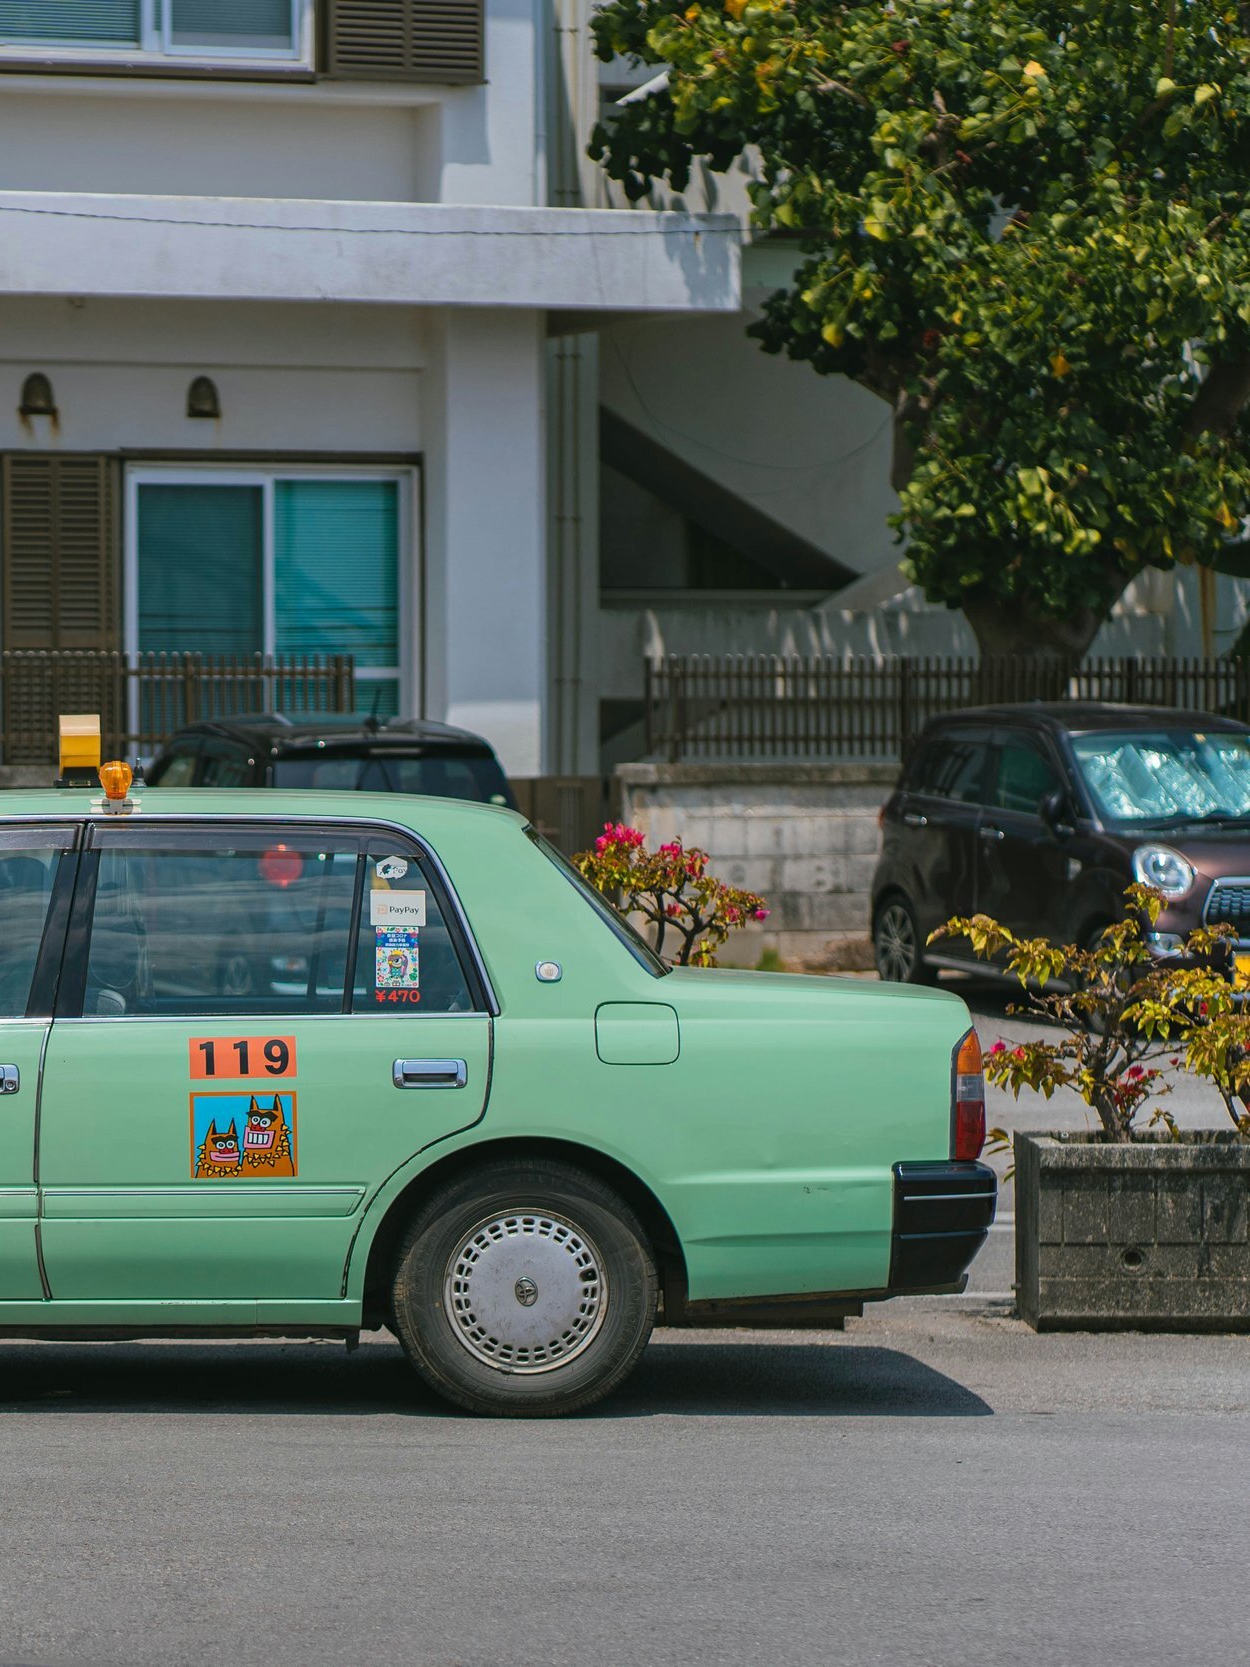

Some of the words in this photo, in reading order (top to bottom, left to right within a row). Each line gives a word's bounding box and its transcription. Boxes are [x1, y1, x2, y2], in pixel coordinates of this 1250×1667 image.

[389, 906, 420, 915] PayPay
[375, 989, 421, 1003] ¥470
[199, 1039, 289, 1076] 119
